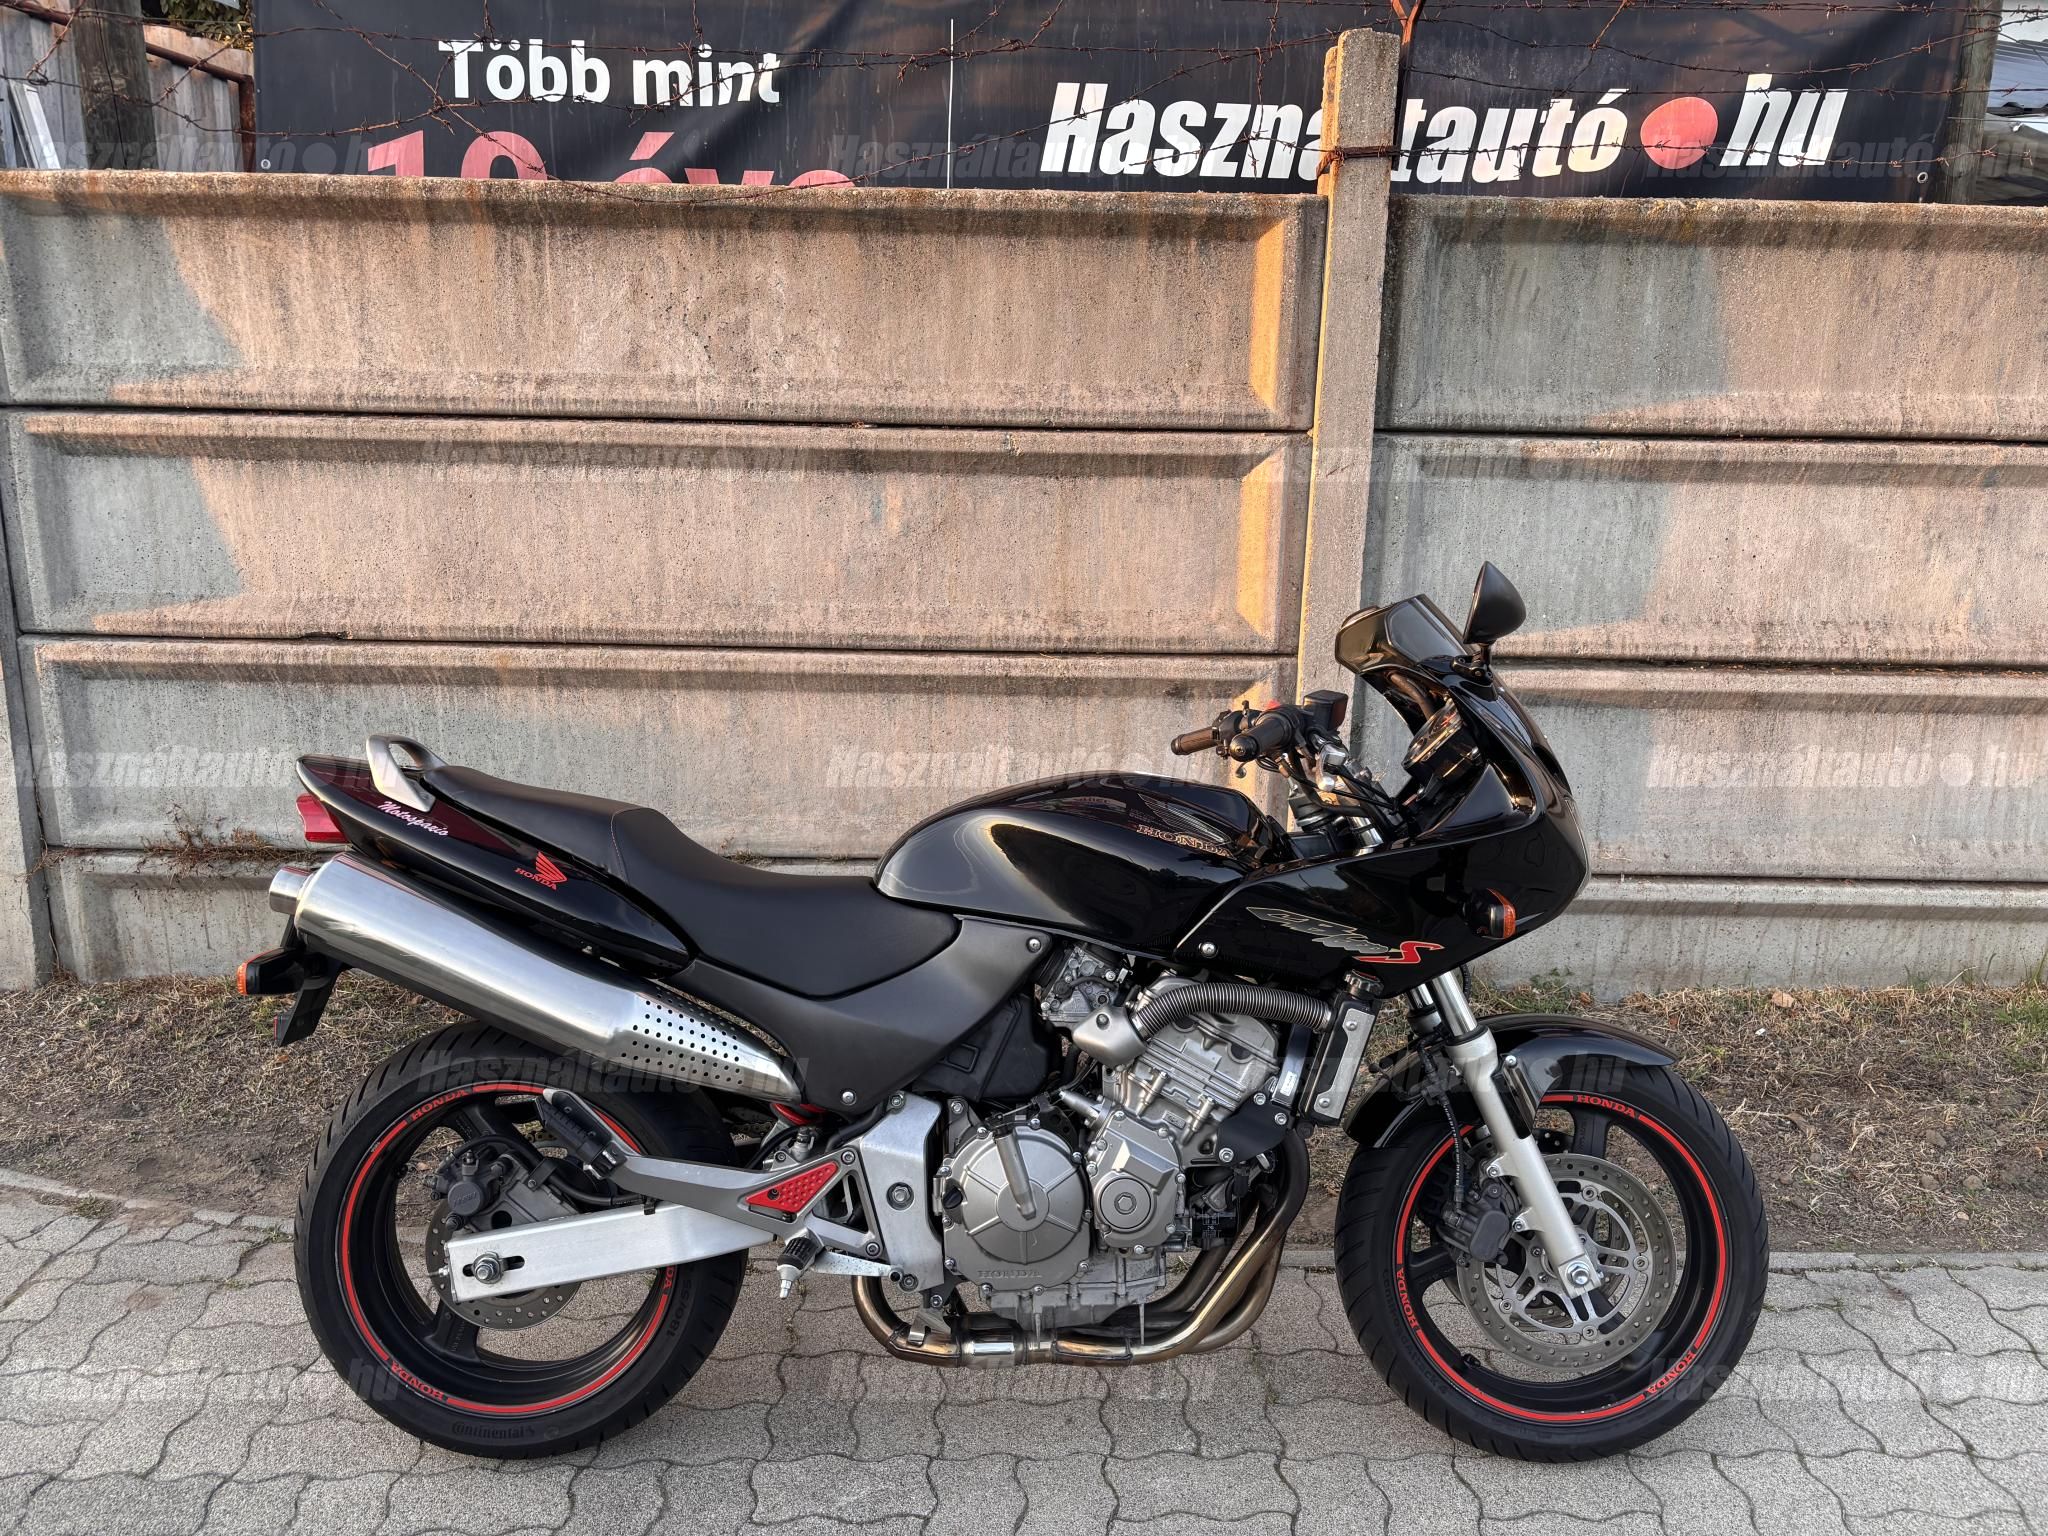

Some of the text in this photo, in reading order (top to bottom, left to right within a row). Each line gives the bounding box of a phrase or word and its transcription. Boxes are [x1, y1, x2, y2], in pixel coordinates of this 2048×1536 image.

[438, 39, 780, 106] Több mint
[1040, 82, 1630, 186] Haszntautó
[1136, 824, 1237, 860] HONDA
[514, 867, 557, 890] HONDA
[410, 1089, 470, 1121] HONDA
[1577, 1094, 1636, 1118] HONDA
[978, 1269, 1042, 1279] HONDA
[1396, 1267, 1420, 1331] HONDA
[390, 1361, 444, 1400] HONDA
[1647, 1350, 1697, 1394] HONDA
